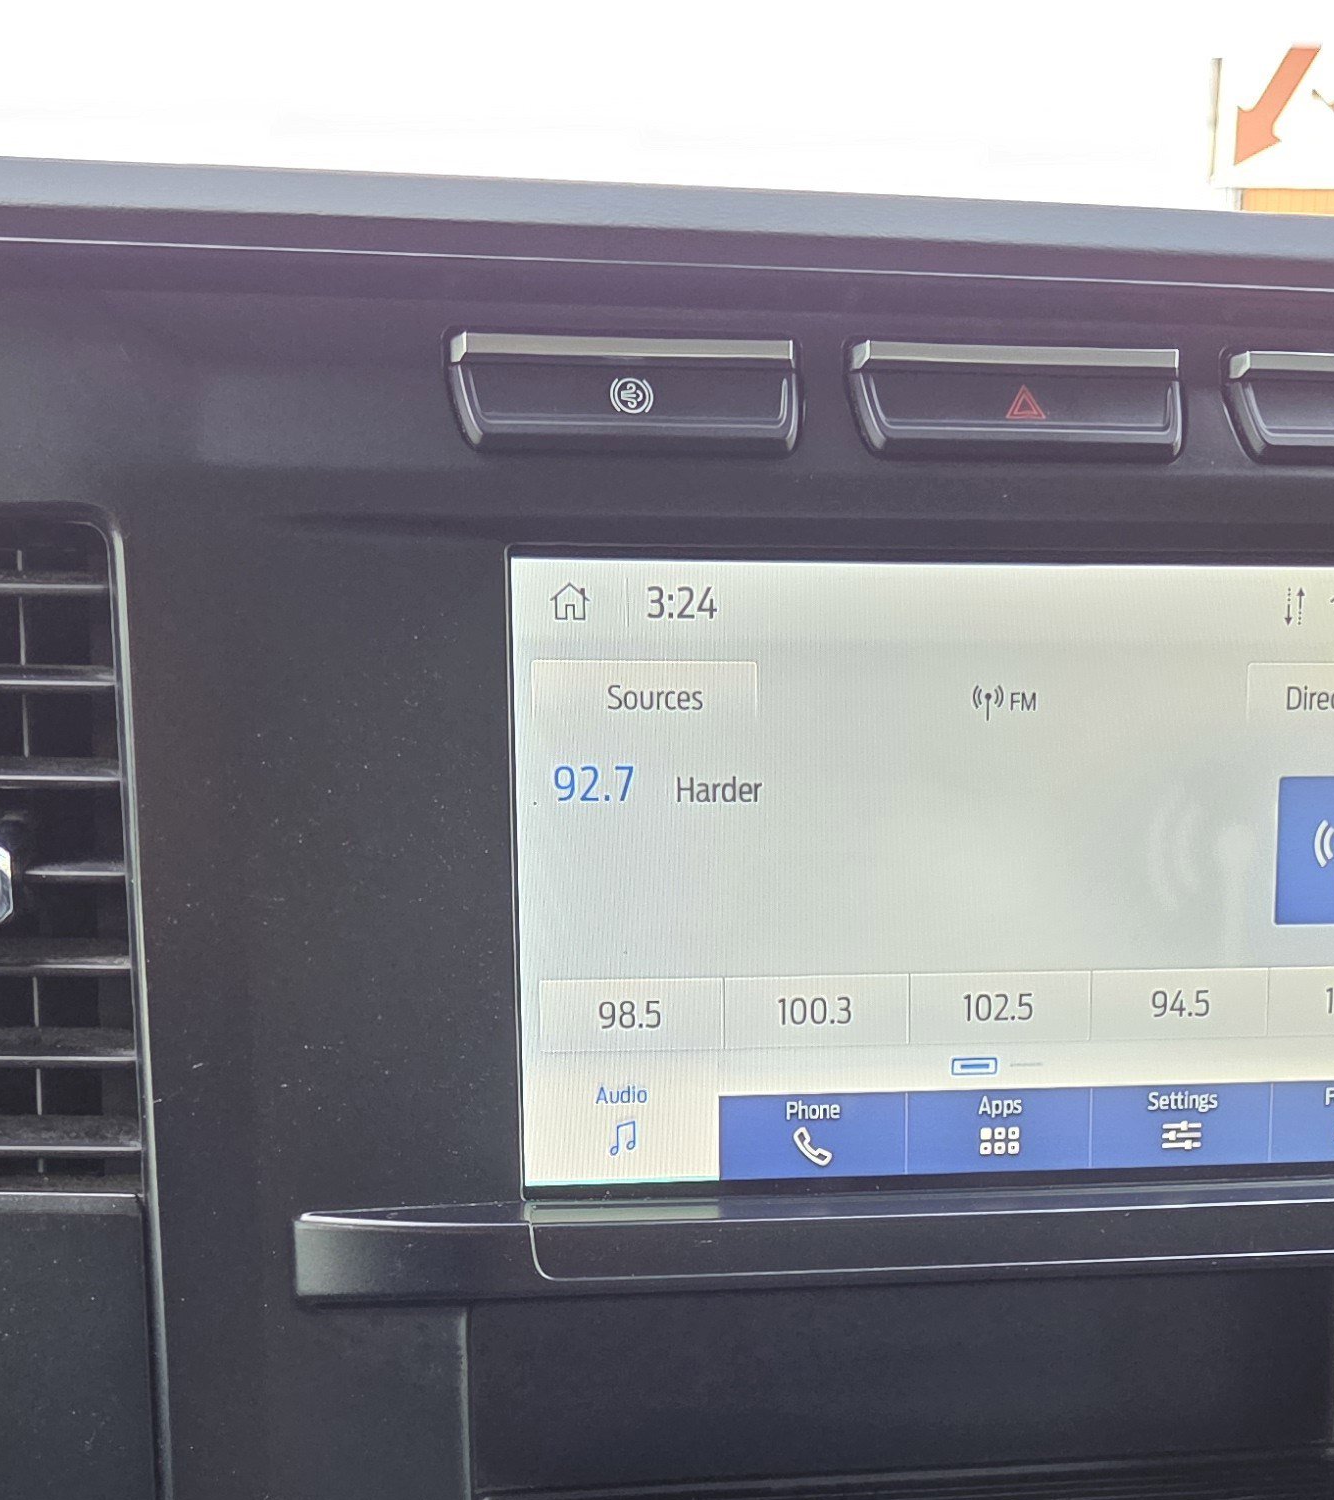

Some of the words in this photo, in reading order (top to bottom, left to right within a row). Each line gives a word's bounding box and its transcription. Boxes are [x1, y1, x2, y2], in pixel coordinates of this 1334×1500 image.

[646, 586, 718, 620] 3:24
[607, 684, 704, 711] Sources
[1009, 692, 1038, 712] FM
[553, 765, 635, 802] 92.7
[675, 776, 763, 803] Harder
[598, 999, 662, 1030] 98.5
[778, 995, 852, 1026] 100.3
[963, 992, 1034, 1023] 102.5
[1151, 989, 1210, 1018] 94.5
[596, 1086, 648, 1105] Audio
[978, 1096, 1023, 1116] Apps
[1147, 1090, 1218, 1113] Settings
[785, 1099, 841, 1121] Phone
